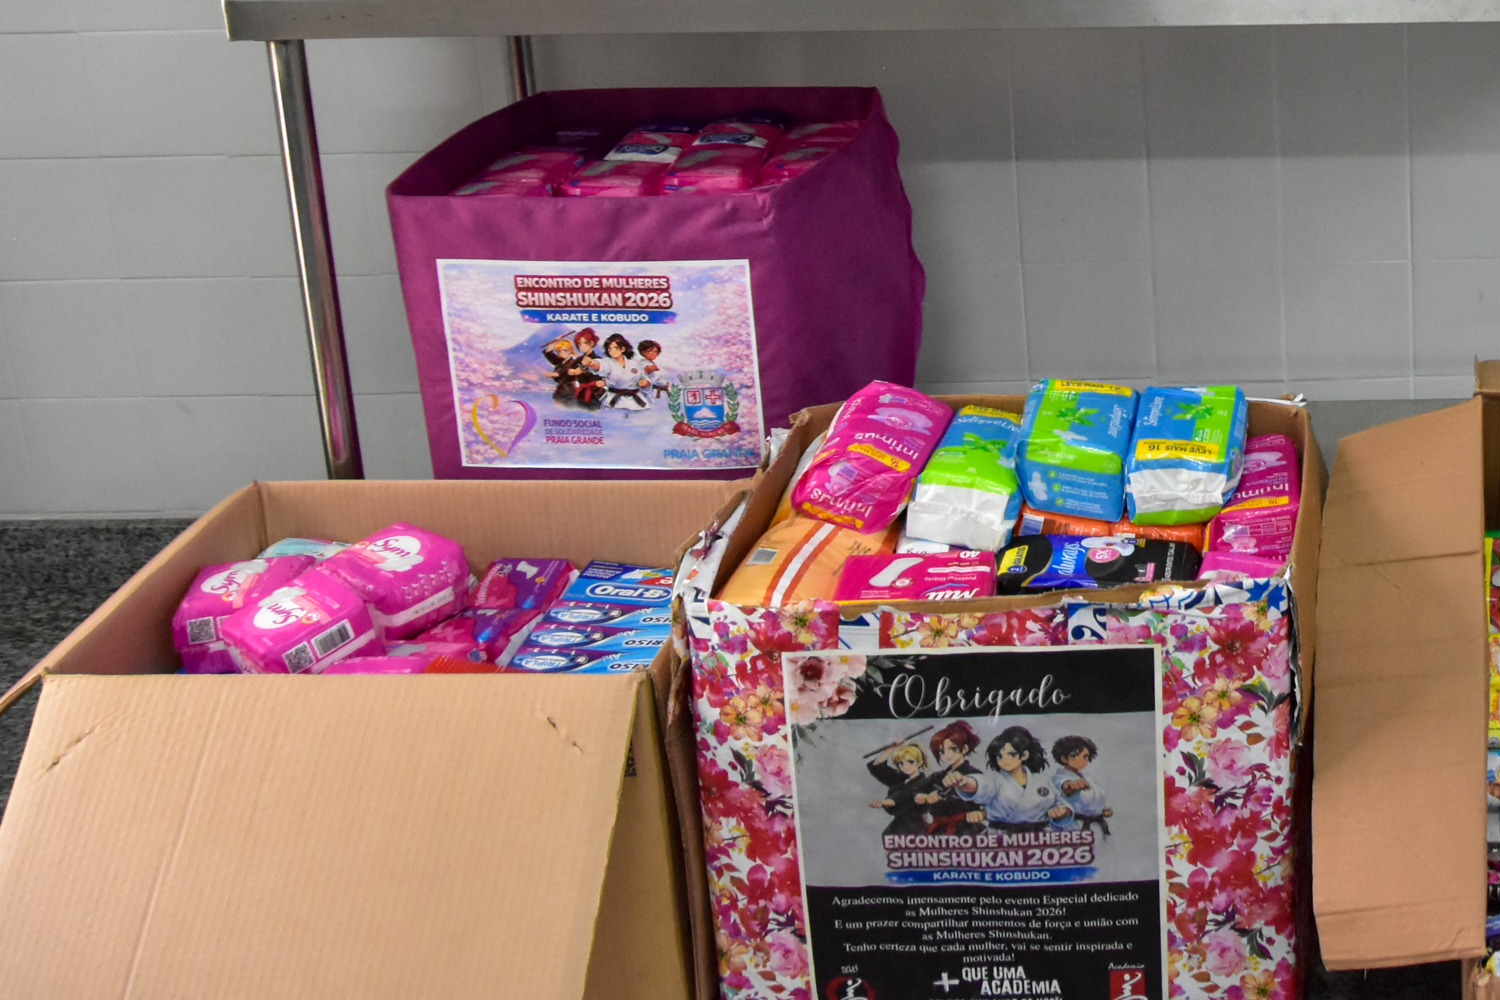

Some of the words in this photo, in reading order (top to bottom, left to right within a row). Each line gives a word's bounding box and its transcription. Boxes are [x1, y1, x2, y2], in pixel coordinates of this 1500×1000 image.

[517, 277, 581, 288] ENCONTRO
[584, 278, 599, 288] DE
[602, 278, 668, 289] MULHERES
[518, 292, 623, 307] SHINSHUKAN
[625, 292, 671, 307] 2026
[546, 313, 589, 322] KARATE
[601, 313, 648, 322] KOBUDO
[544, 420, 572, 428] FUNDO
[573, 420, 602, 428] SOCIAL
[546, 436, 570, 444] PRAIA
[571, 436, 604, 444] GRANDE
[854, 432, 919, 460] Intimus
[1052, 541, 1086, 575] always
[594, 585, 665, 598] Oral-B
[877, 673, 1071, 725] Obrigado
[884, 834, 973, 849] ENCONTRO
[976, 834, 998, 847] DE
[1002, 830, 1093, 846] MULHERES
[889, 850, 1025, 868] SHINSHUKAN
[1027, 846, 1092, 865] 2026
[933, 872, 981, 881] KARATE
[985, 872, 992, 881] E
[996, 871, 1050, 881] KOBUDO
[832, 896, 904, 908] Agradecemos
[907, 896, 976, 905] imensamente
[980, 896, 1002, 906] pelo
[1005, 896, 1040, 905] evento
[1043, 894, 1087, 906] Especial
[1090, 892, 1139, 902] dedicado
[919, 907, 968, 916] Mulheres
[972, 907, 1033, 917] Shinshukan
[1036, 907, 1066, 916] 2026!
[866, 920, 899, 930] prazer
[901, 919, 969, 930] compartilhar
[972, 919, 1026, 928] momentos
[1029, 919, 1041, 928] de
[1045, 919, 1072, 930] força
[1084, 918, 1113, 927] união
[1116, 918, 1139, 926] com
[936, 931, 985, 940] Mulheres
[989, 930, 1052, 940] Shinshukan.
[843, 943, 877, 952] Tenho
[879, 943, 916, 952] certeza
[919, 945, 938, 953] que
[941, 943, 965, 952] cada
[968, 942, 1008, 951] mulher,
[1043, 943, 1073, 951] sentir
[1076, 941, 1124, 952] inspirada
[963, 953, 1015, 962] motivada!
[962, 967, 989, 982] QUE
[993, 966, 1026, 980] UMA
[980, 979, 1061, 995] ACADEMIA
